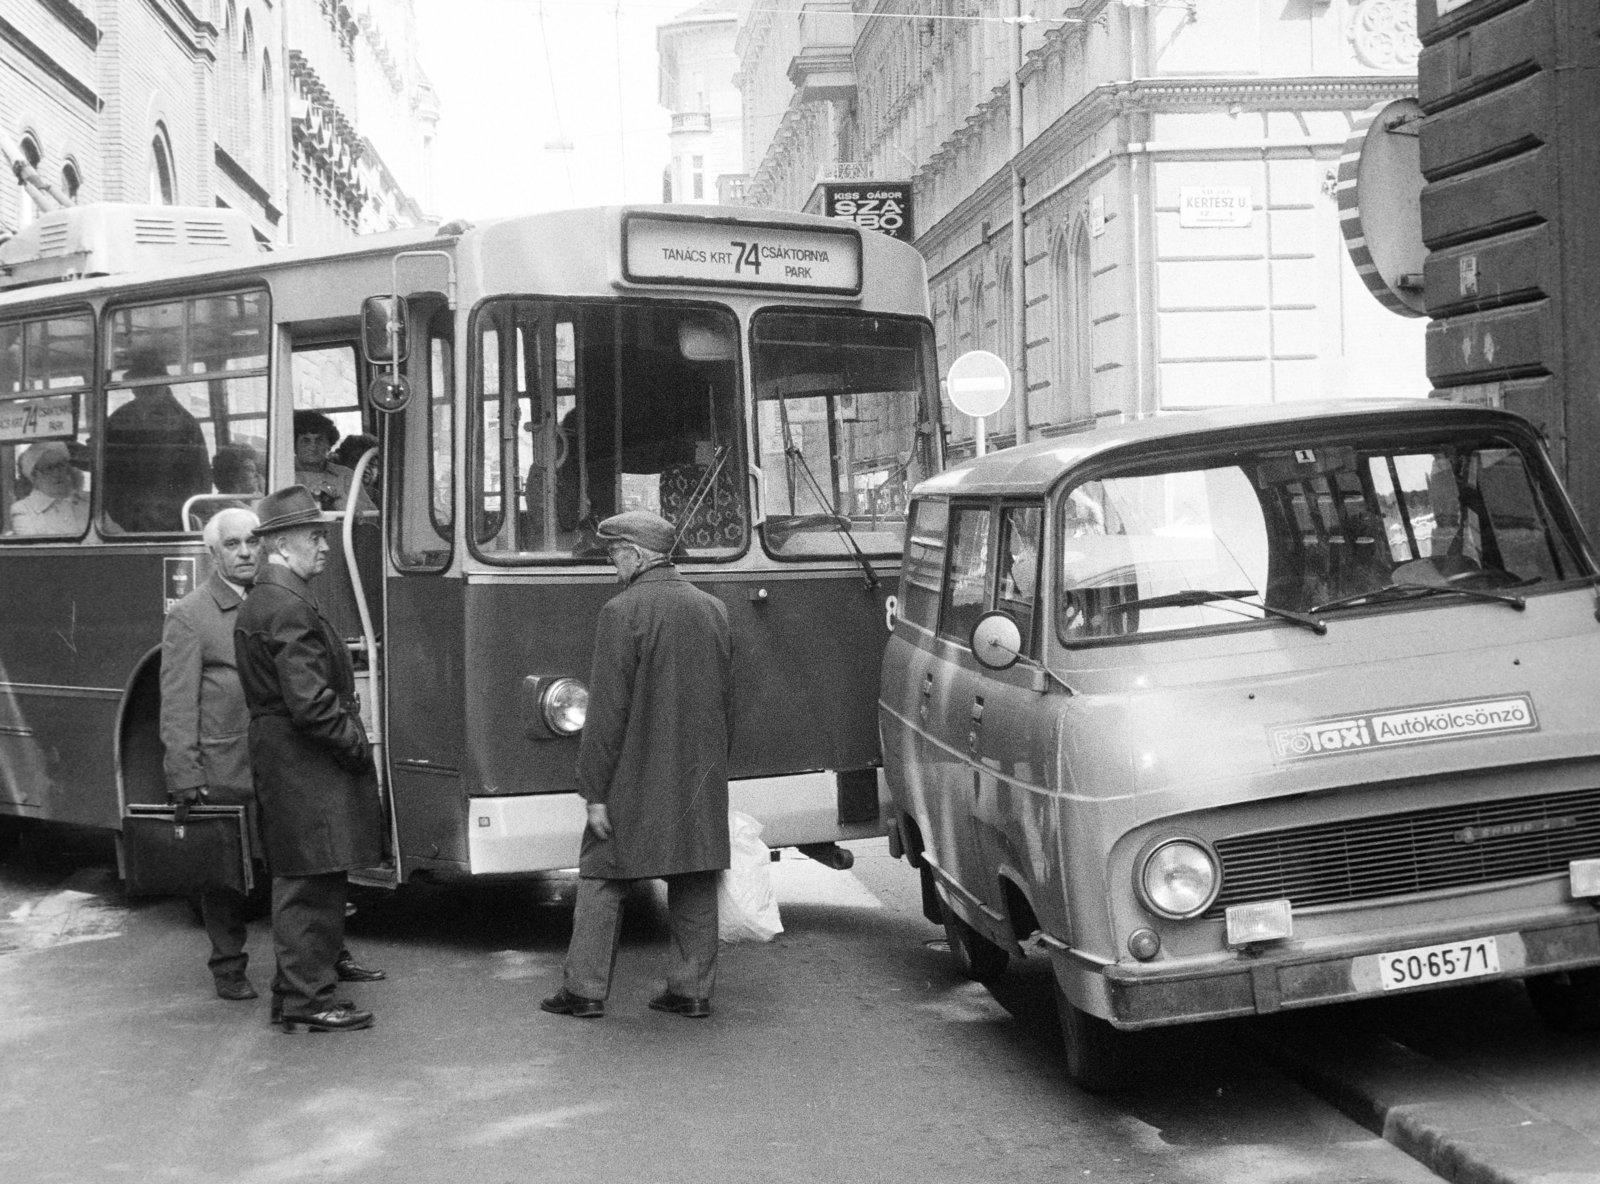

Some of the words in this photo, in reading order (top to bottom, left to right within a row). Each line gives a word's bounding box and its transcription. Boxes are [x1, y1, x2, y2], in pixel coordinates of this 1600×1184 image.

[834, 192, 860, 200] KISS
[866, 190, 903, 199] GÁBOR
[1186, 195, 1234, 208] KERTÉSZ
[1238, 197, 1249, 208] U.
[662, 246, 707, 263] TANÁCS
[710, 251, 733, 264] KRT.
[730, 241, 762, 275] 74
[761, 244, 830, 263] CSÁKTORNYA
[785, 265, 812, 279] PARK
[22, 405, 38, 434] 74
